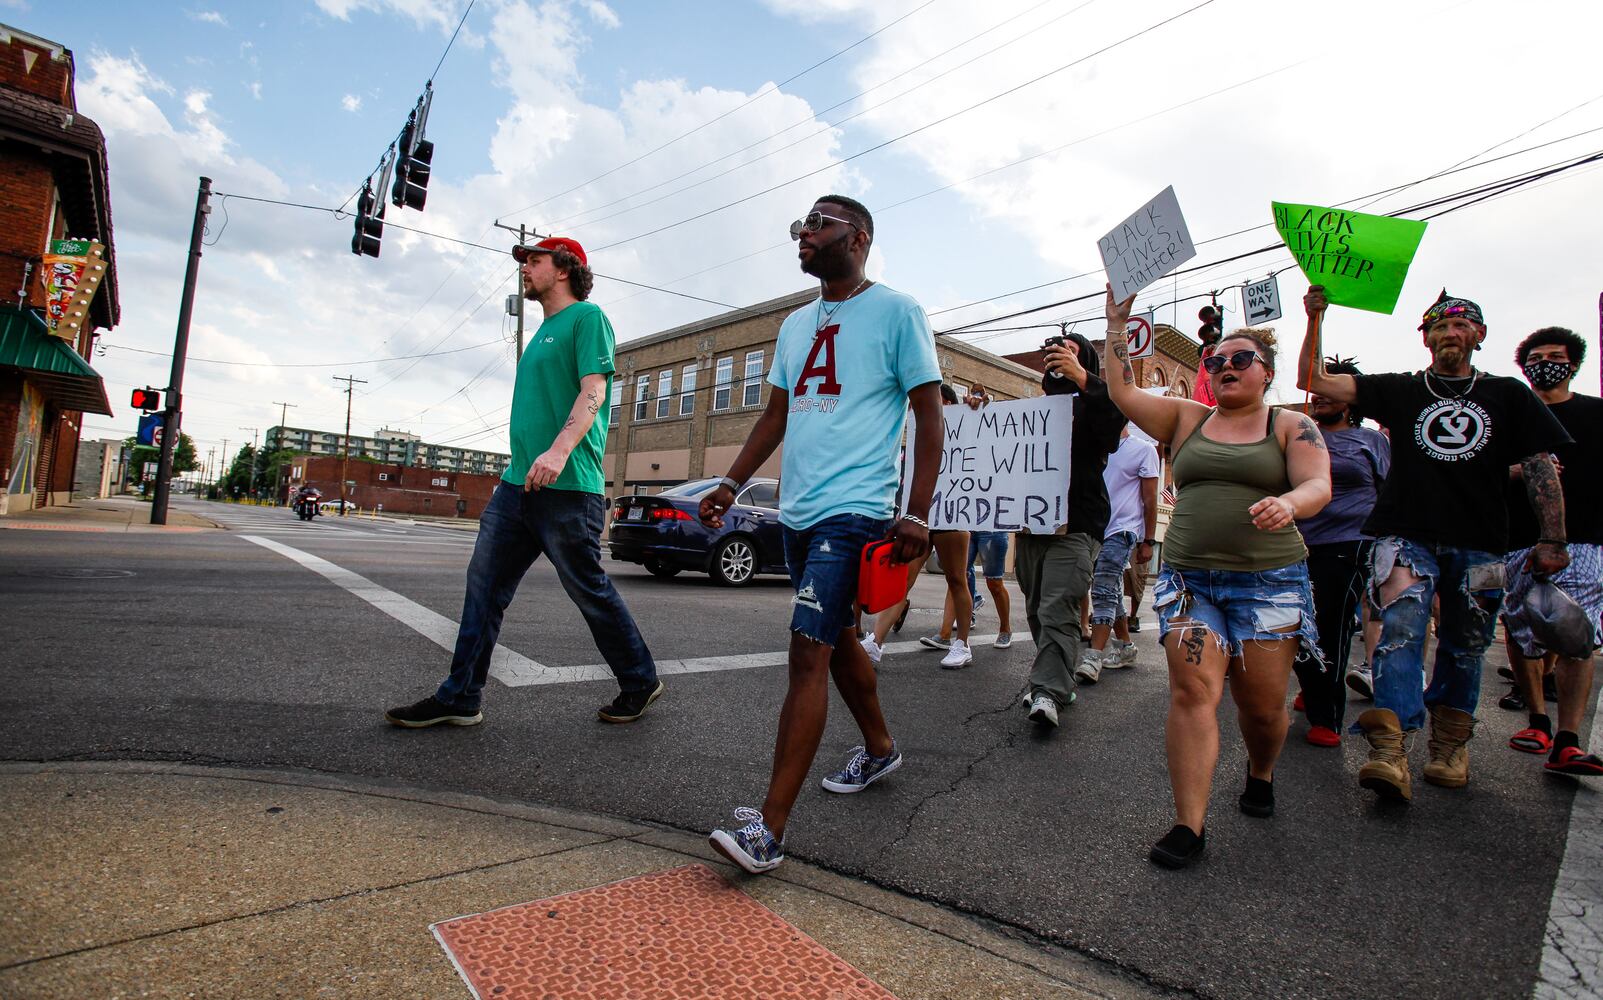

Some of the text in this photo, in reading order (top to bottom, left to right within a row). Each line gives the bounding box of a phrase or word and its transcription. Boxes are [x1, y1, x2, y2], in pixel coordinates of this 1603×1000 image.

[1274, 207, 1357, 234] BLACK
[1098, 205, 1161, 267] BLACK
[1124, 225, 1171, 273] LIVES
[1286, 230, 1351, 255] LIVES
[1296, 253, 1374, 282] MATTER
[1248, 282, 1272, 297] ONE
[1248, 293, 1273, 308] WAY
[794, 324, 842, 397] A
[977, 409, 1051, 439] MANY
[1417, 403, 1437, 422] WORLD
[1466, 400, 1477, 409] TO
[1475, 407, 1492, 426] DEATH
[991, 442, 1060, 474] WILL
